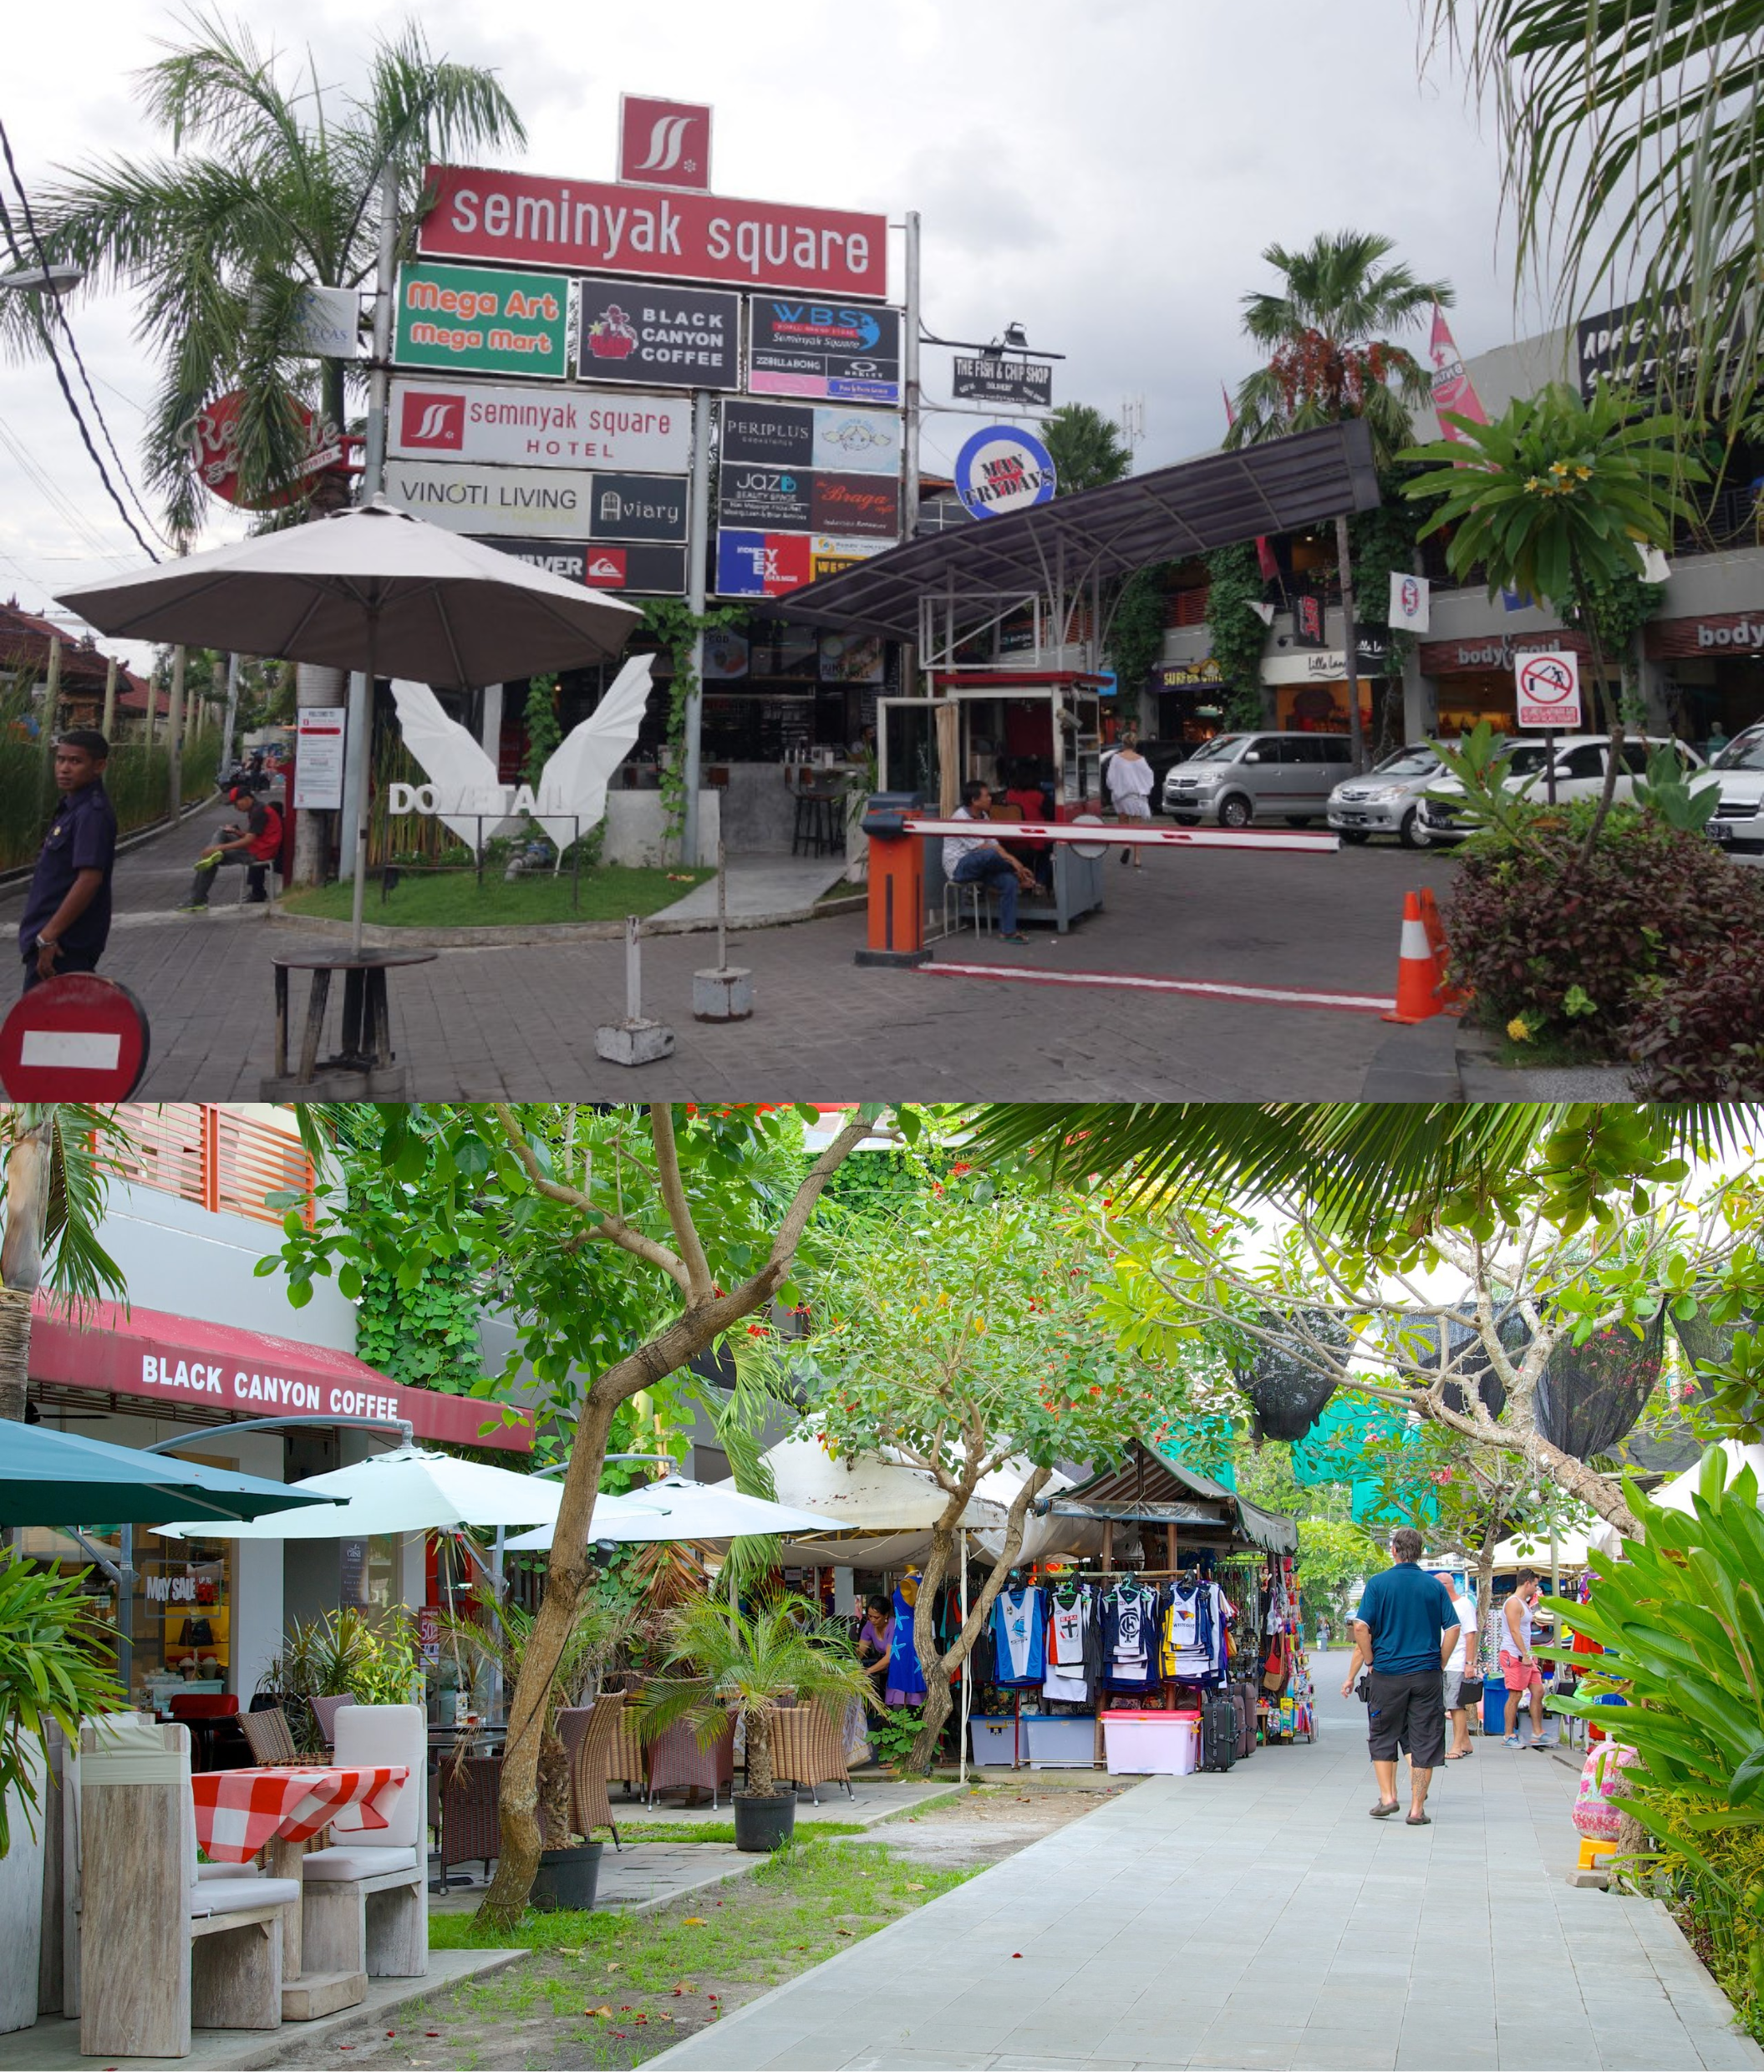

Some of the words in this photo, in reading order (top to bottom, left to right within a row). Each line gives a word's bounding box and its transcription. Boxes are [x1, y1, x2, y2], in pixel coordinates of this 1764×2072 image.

[451, 188, 683, 260] seminyak
[707, 216, 870, 275] square
[407, 281, 498, 320] Mega
[505, 289, 559, 321] Art
[643, 307, 724, 328] BLACK
[772, 302, 858, 328] WBS
[411, 322, 484, 353] Mega
[488, 328, 552, 354] Mart
[641, 328, 724, 347] CANYON
[772, 332, 821, 347] Seminyak
[823, 338, 861, 350] Square
[641, 348, 723, 367] COFFEE
[768, 358, 821, 370] BILLABONG
[956, 358, 974, 376] THE
[975, 360, 994, 379] FISH
[996, 363, 1003, 379] &
[1005, 363, 1024, 382] CHIP
[1026, 366, 1050, 384] SHOP
[470, 402, 577, 431] seminyak
[589, 411, 671, 435] square
[727, 420, 810, 439] PERIPLUS
[526, 439, 614, 458] HOTEL
[400, 480, 488, 505] VINOTI
[501, 486, 577, 510] LIVING
[821, 485, 890, 512] Braga
[142, 1354, 223, 1394] BLACK
[234, 1371, 320, 1410] CANYON
[329, 1388, 399, 1420] COFFEE
[147, 1576, 172, 1602] MAY
[172, 1577, 196, 1601] SALE
